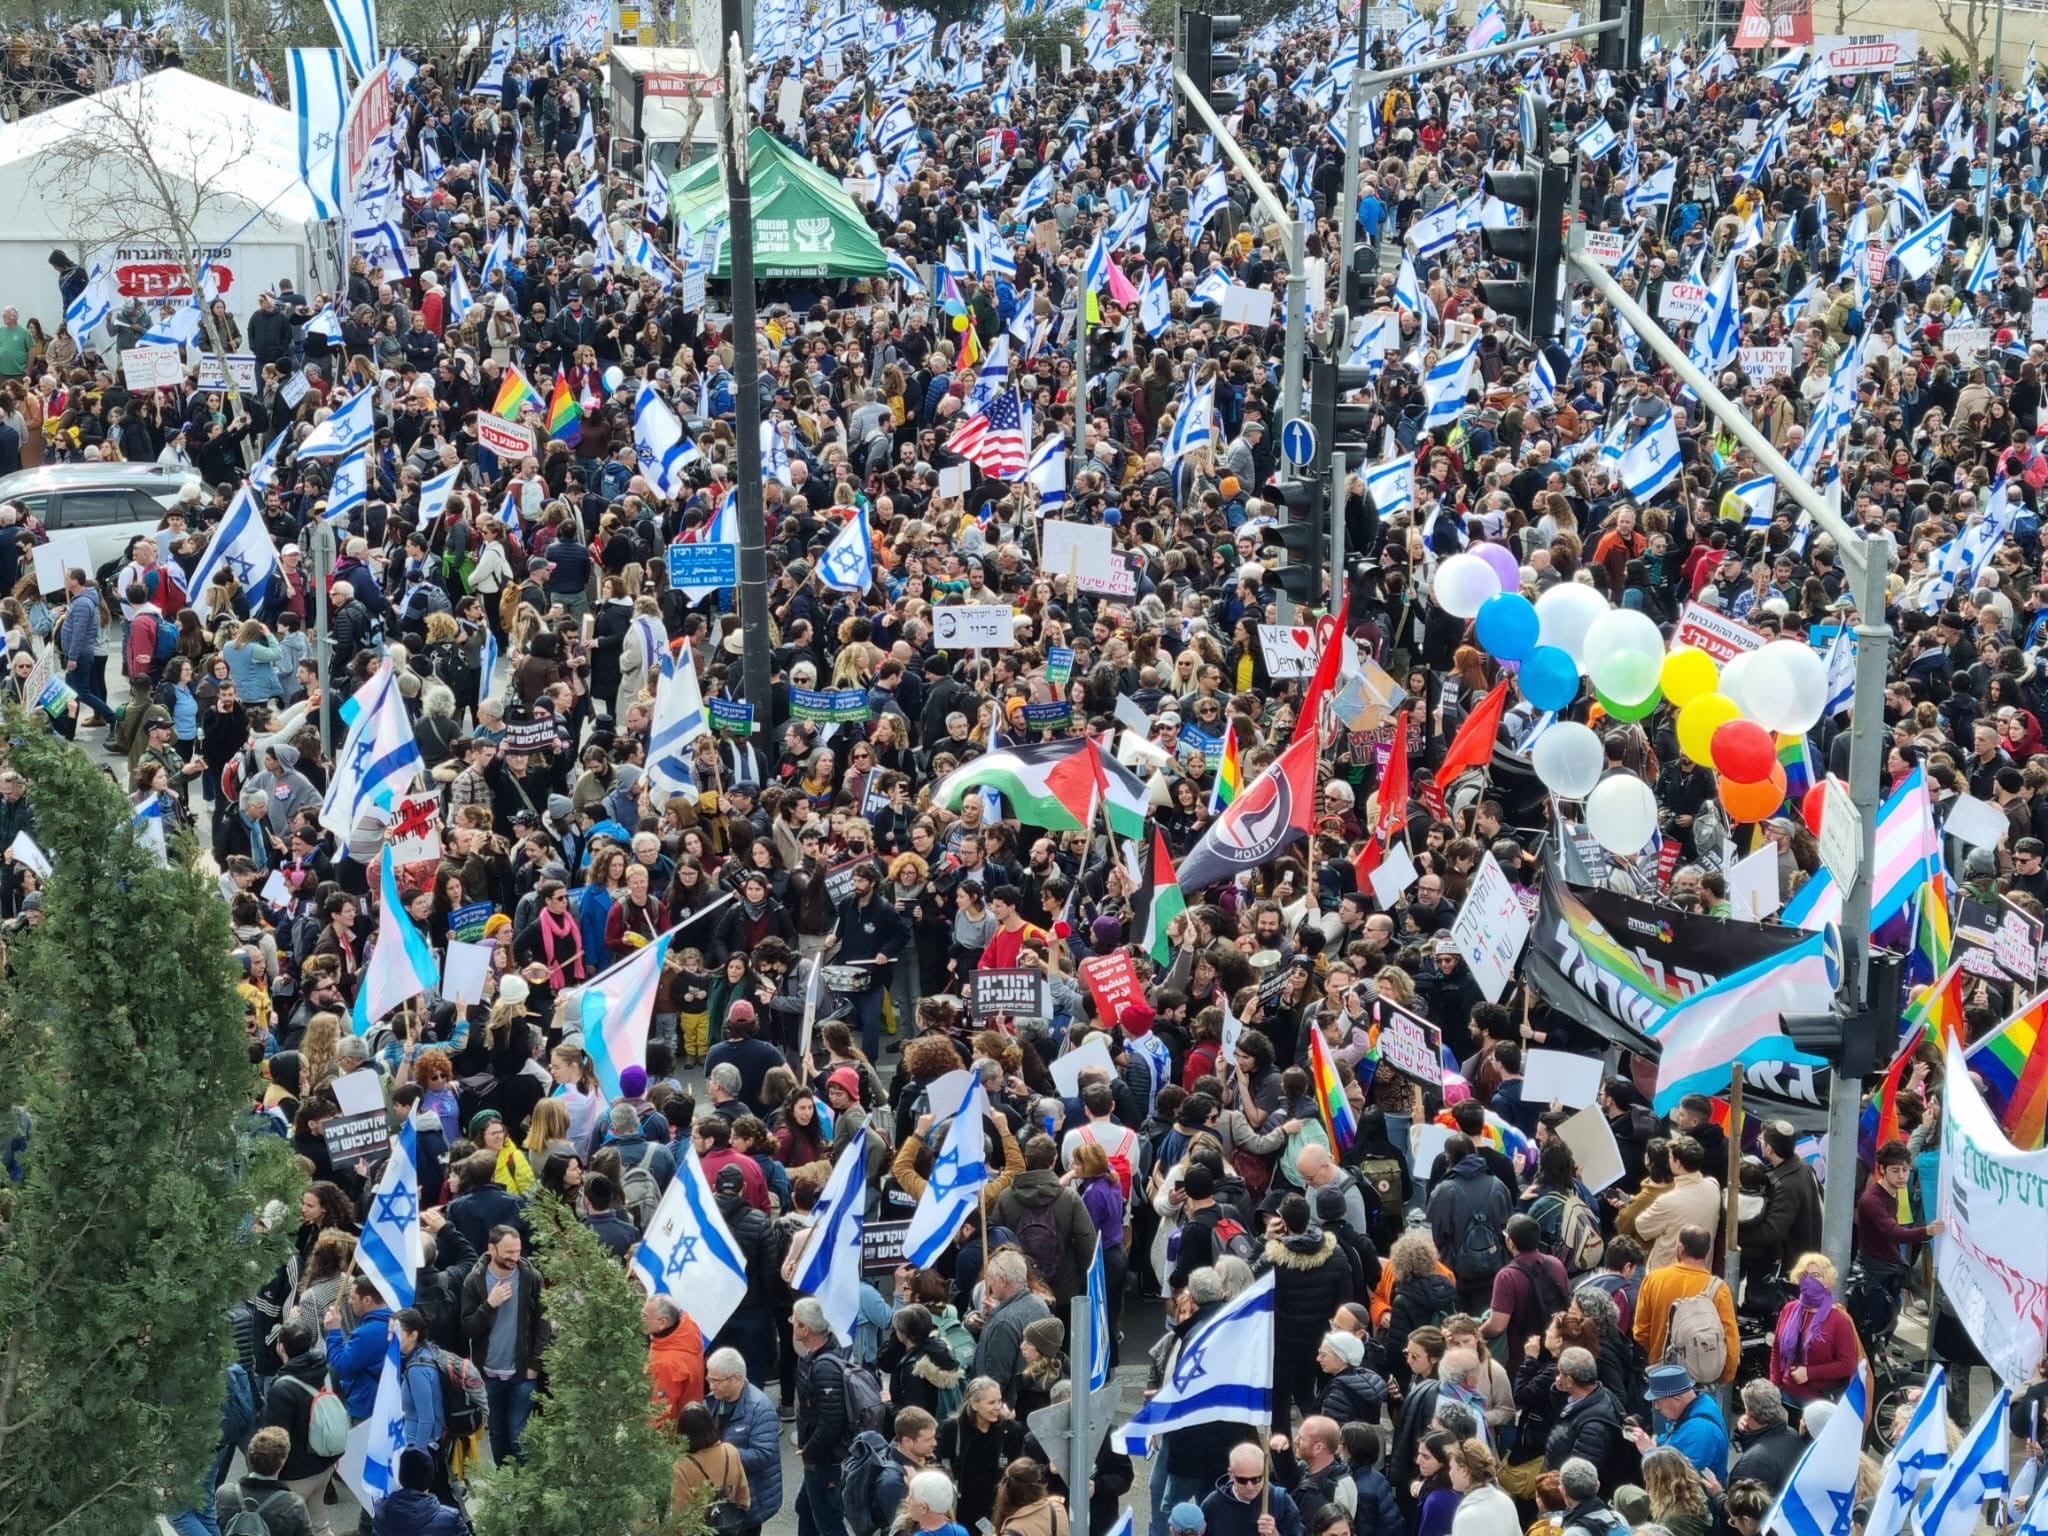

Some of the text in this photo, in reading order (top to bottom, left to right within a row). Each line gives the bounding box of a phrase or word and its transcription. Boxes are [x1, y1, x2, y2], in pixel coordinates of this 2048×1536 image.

[1260, 626, 1289, 644] We
[977, 975, 1034, 990] יהודית
[978, 989, 1036, 1003] וגזענית
[325, 1116, 386, 1139] אין דמוקרטיה
[340, 1129, 388, 1151] עם כיבוש
